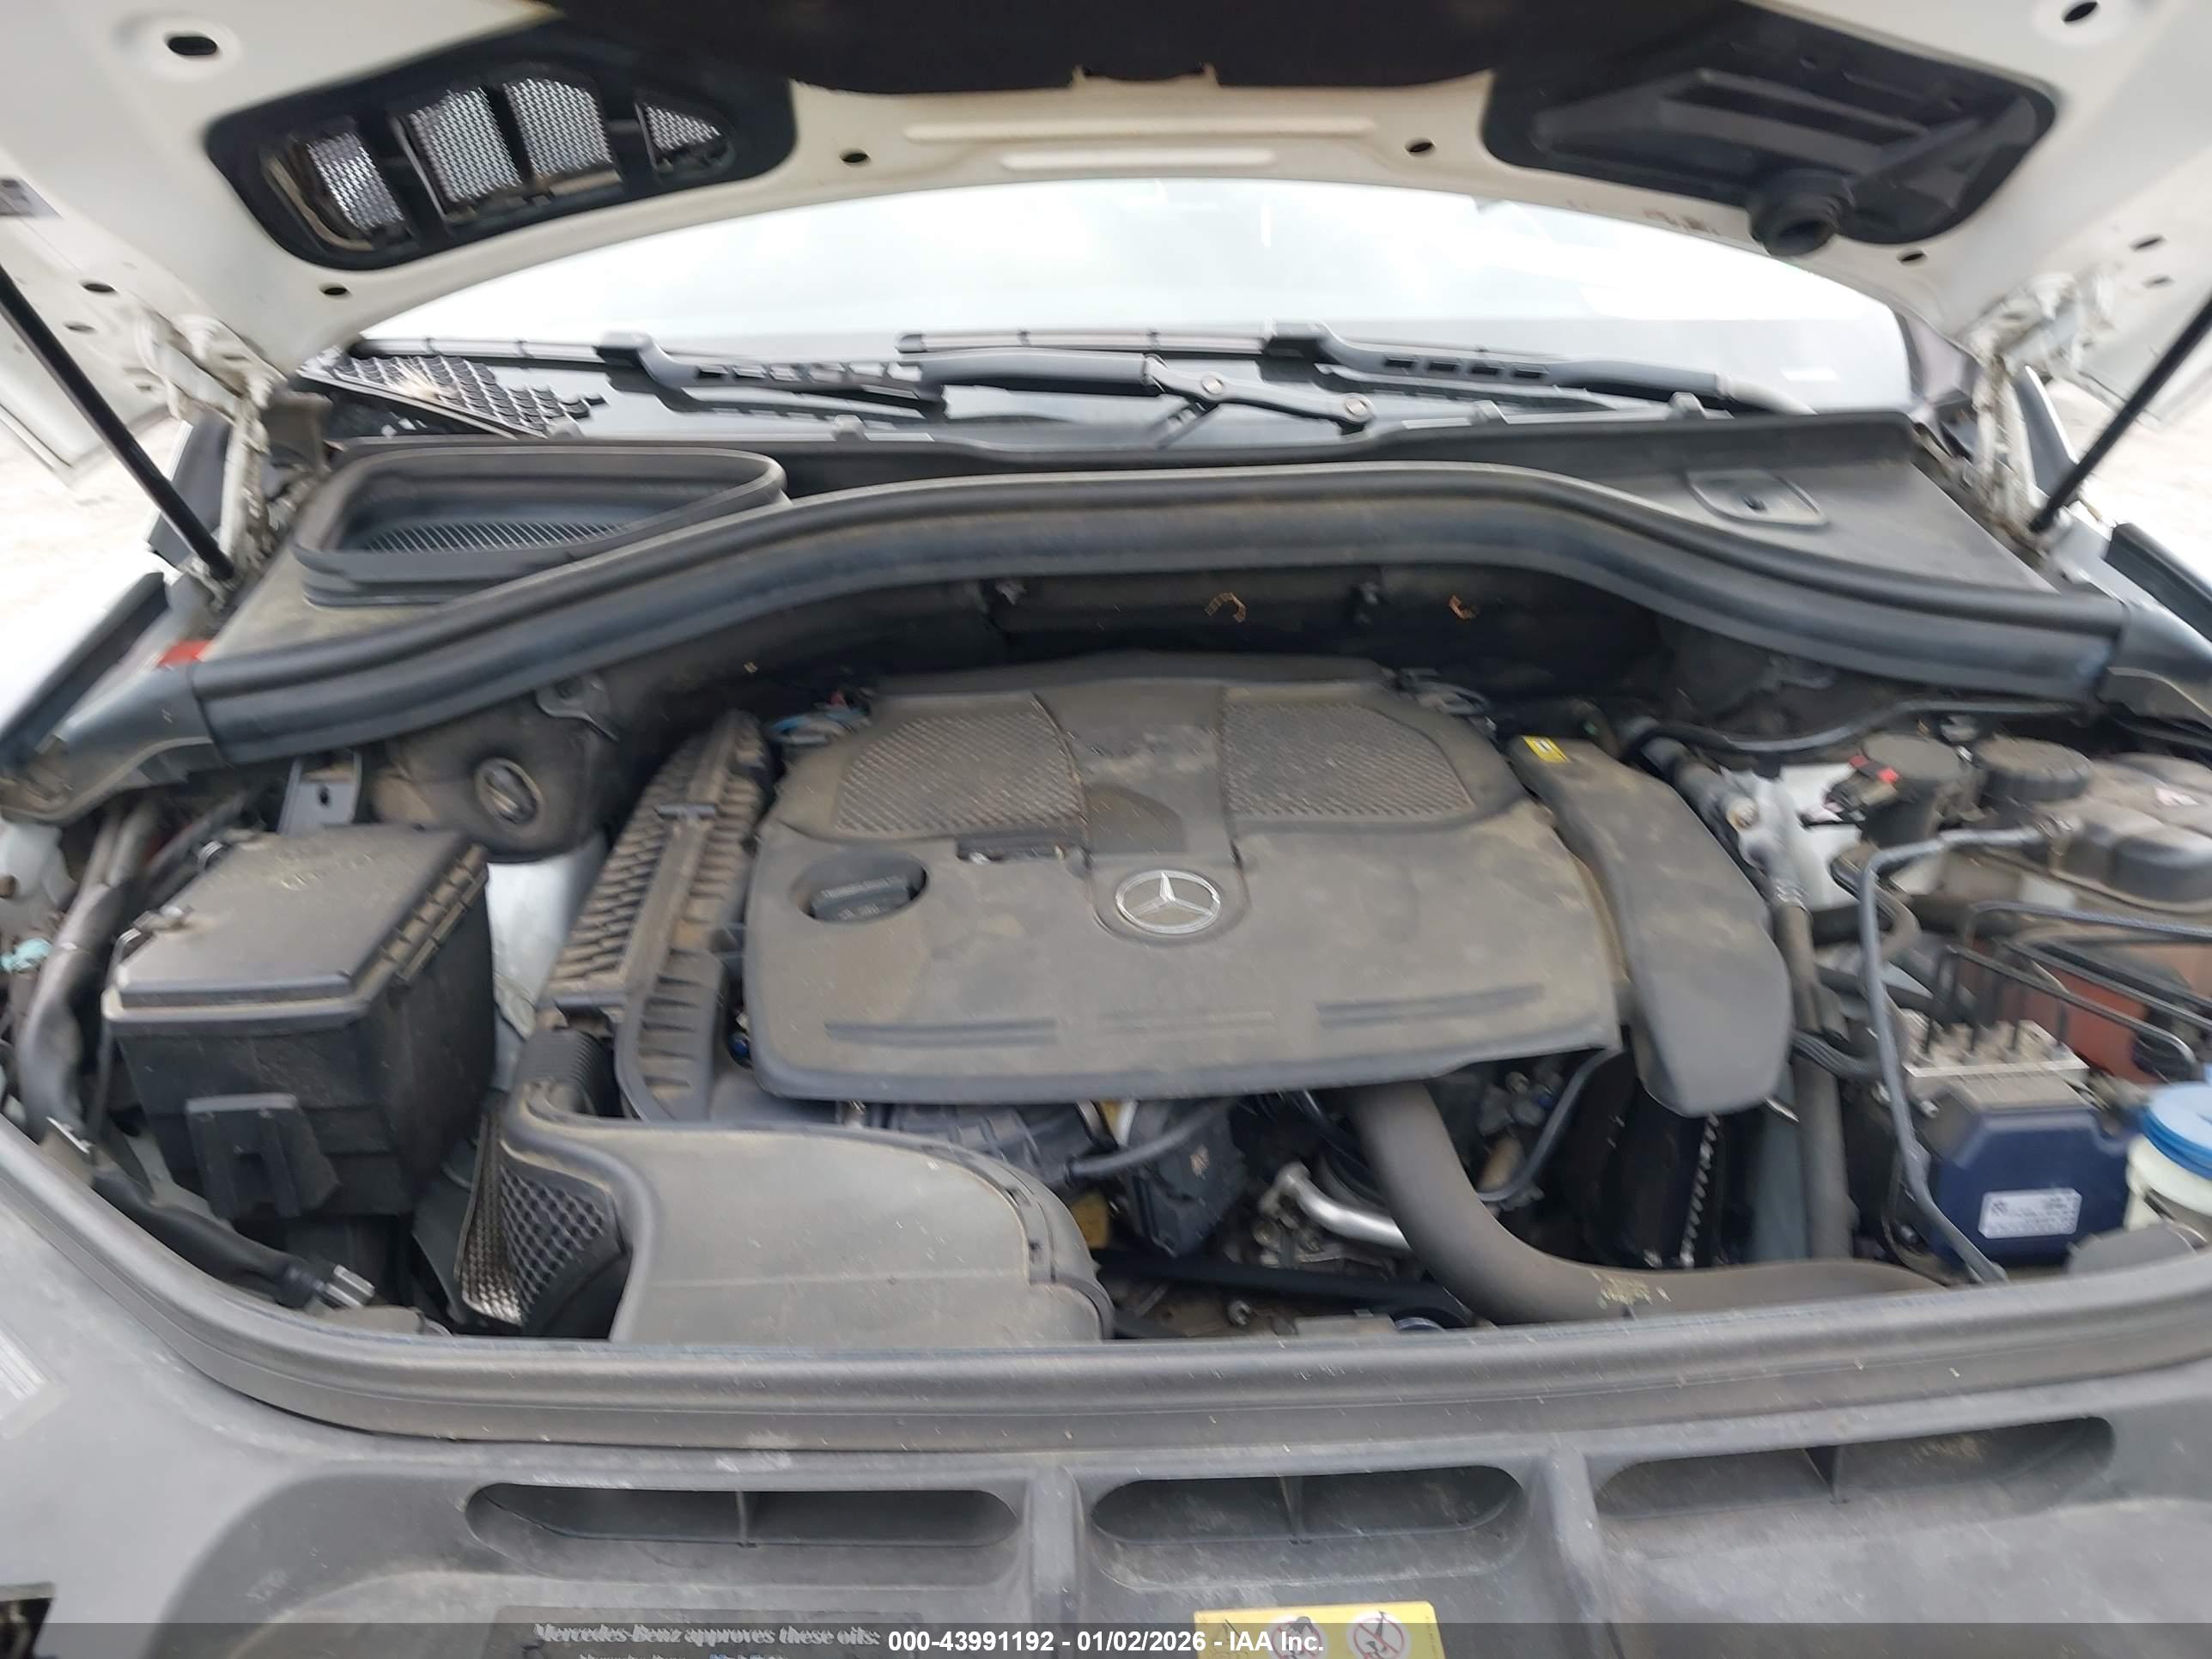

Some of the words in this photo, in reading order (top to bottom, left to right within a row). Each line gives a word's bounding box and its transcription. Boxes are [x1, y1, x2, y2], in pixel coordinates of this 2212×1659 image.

[533, 1623, 683, 1643] Mercedes-Benz
[684, 1628, 775, 1647] approves
[779, 1626, 834, 1644] these
